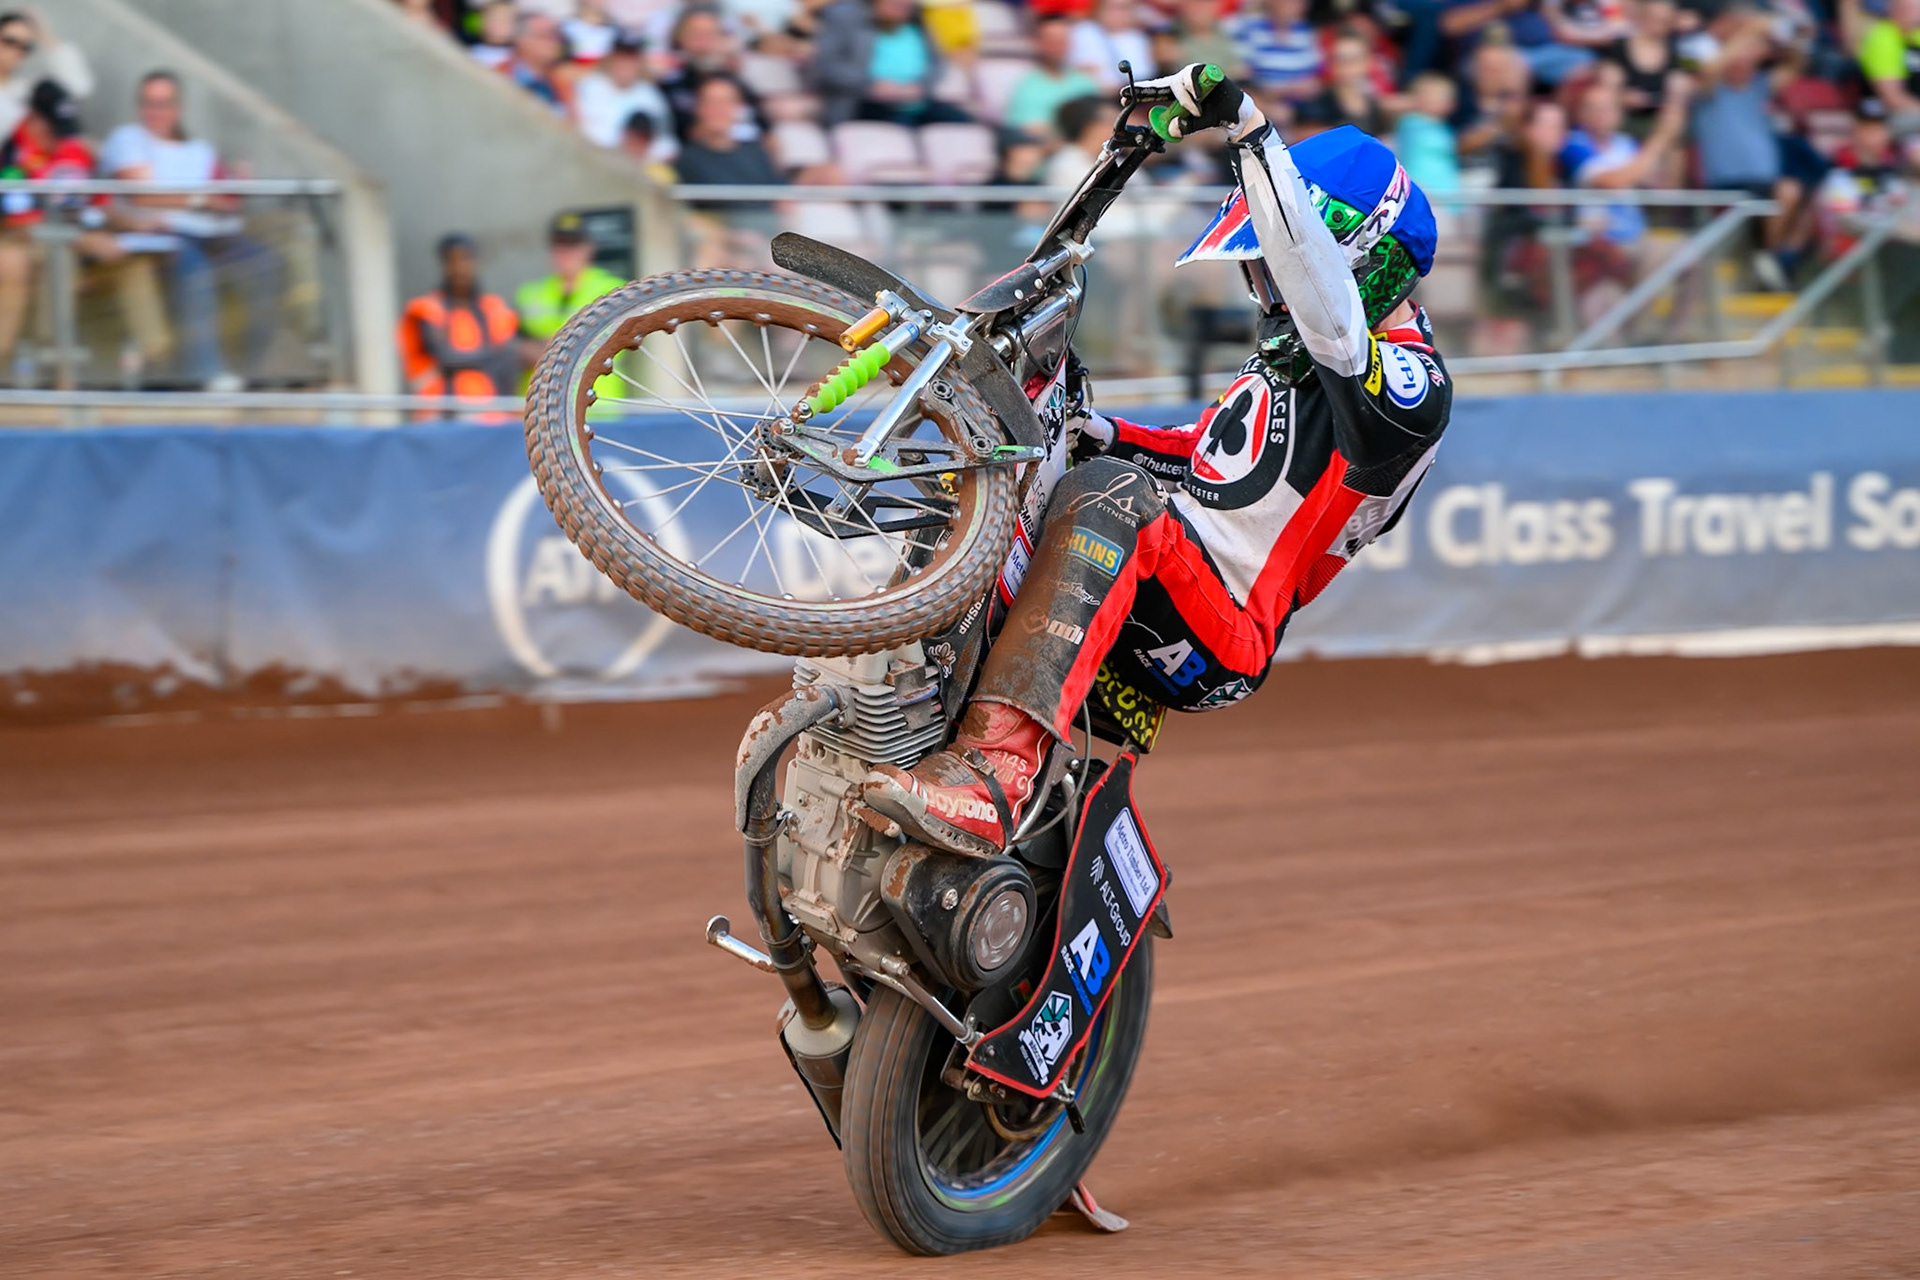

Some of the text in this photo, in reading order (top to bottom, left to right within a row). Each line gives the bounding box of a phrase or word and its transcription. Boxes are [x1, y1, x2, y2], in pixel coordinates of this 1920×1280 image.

[1270, 390, 1287, 444] ACES
[1097, 502, 1137, 528] FITNESS
[1428, 482, 1615, 568] Class
[1627, 471, 1833, 556] Travel
[1133, 648, 1152, 668] RACE
[1147, 638, 1207, 687] AB
[1115, 821, 1128, 850] Metro
[1126, 843, 1143, 880] Timber
[1100, 880, 1132, 946] ALT-Group
[1069, 918, 1111, 996] AB
